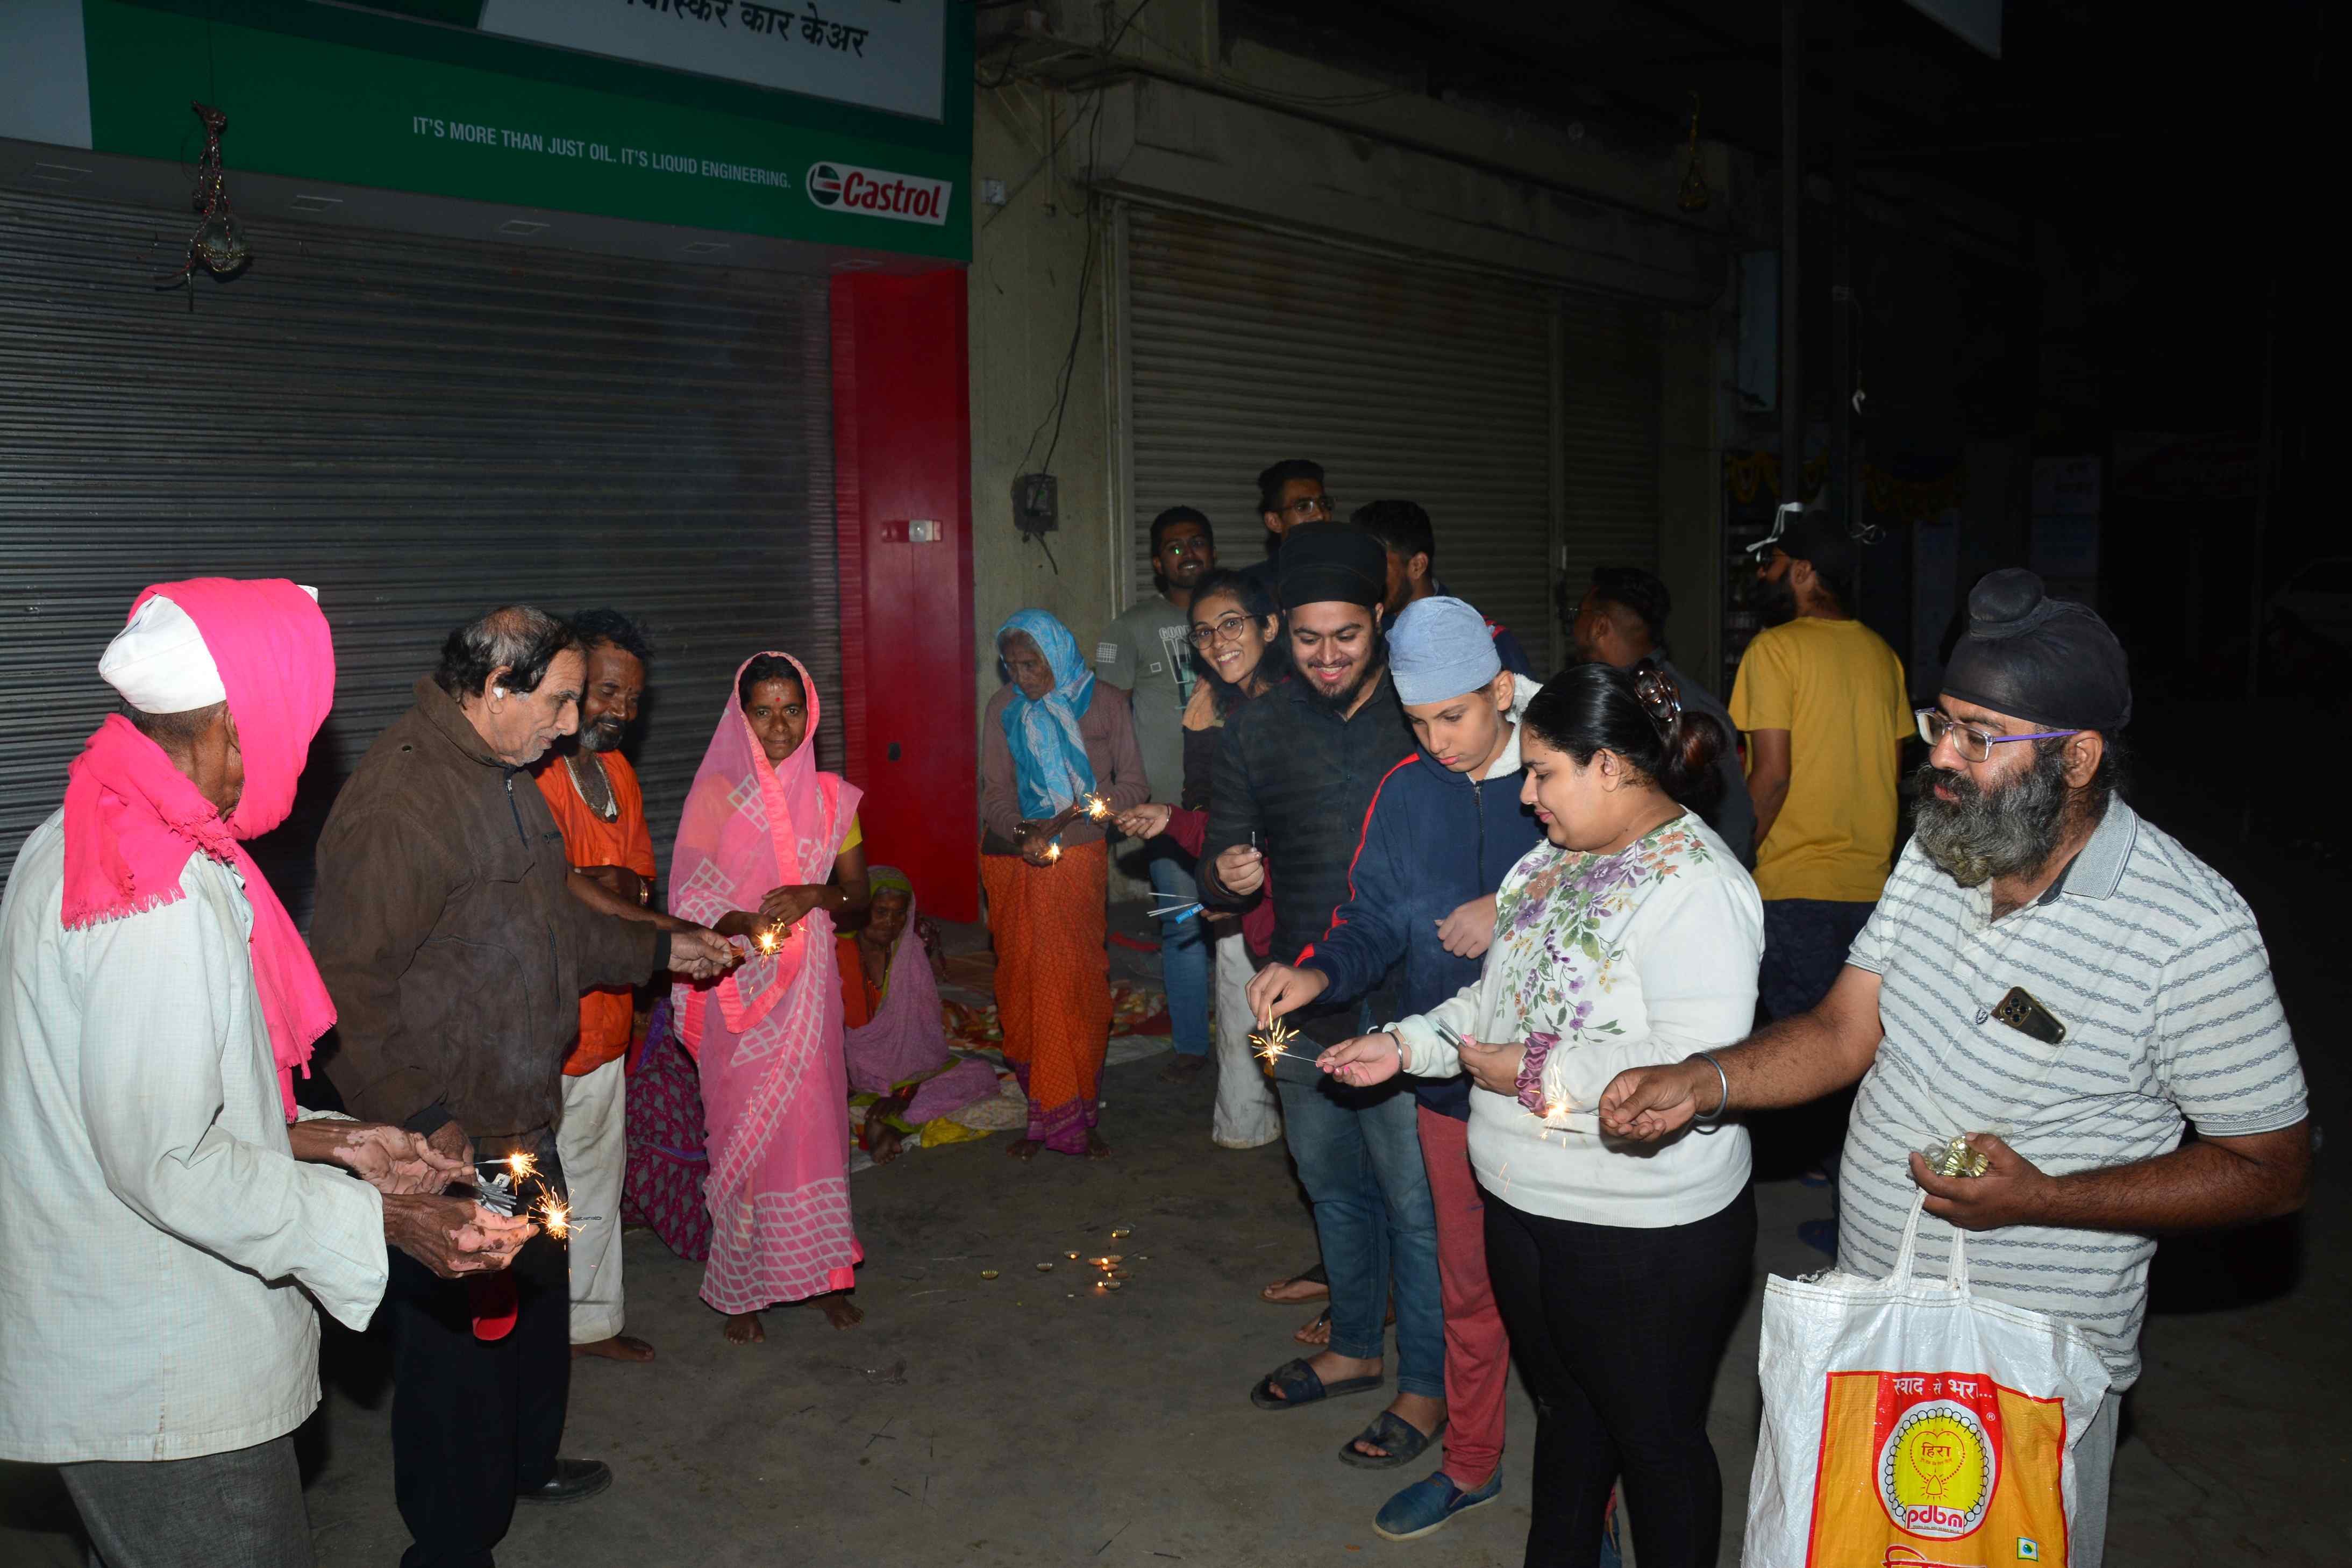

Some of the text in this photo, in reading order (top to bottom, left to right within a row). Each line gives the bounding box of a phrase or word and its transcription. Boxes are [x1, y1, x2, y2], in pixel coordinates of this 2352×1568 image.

[740, 2, 794, 41] कार
[801, 3, 869, 57] केअर
[413, 116, 792, 189] IT'S MORE THAN JUST OIL. IT'S LIQUID ENGINEERING.
[843, 171, 941, 218] Castrol
[1892, 1378, 1925, 1395] स्वाद
[1933, 1378, 1942, 1394] से
[1921, 1442, 1952, 1458] हिरा
[1906, 1505, 1963, 1529] pdbm
